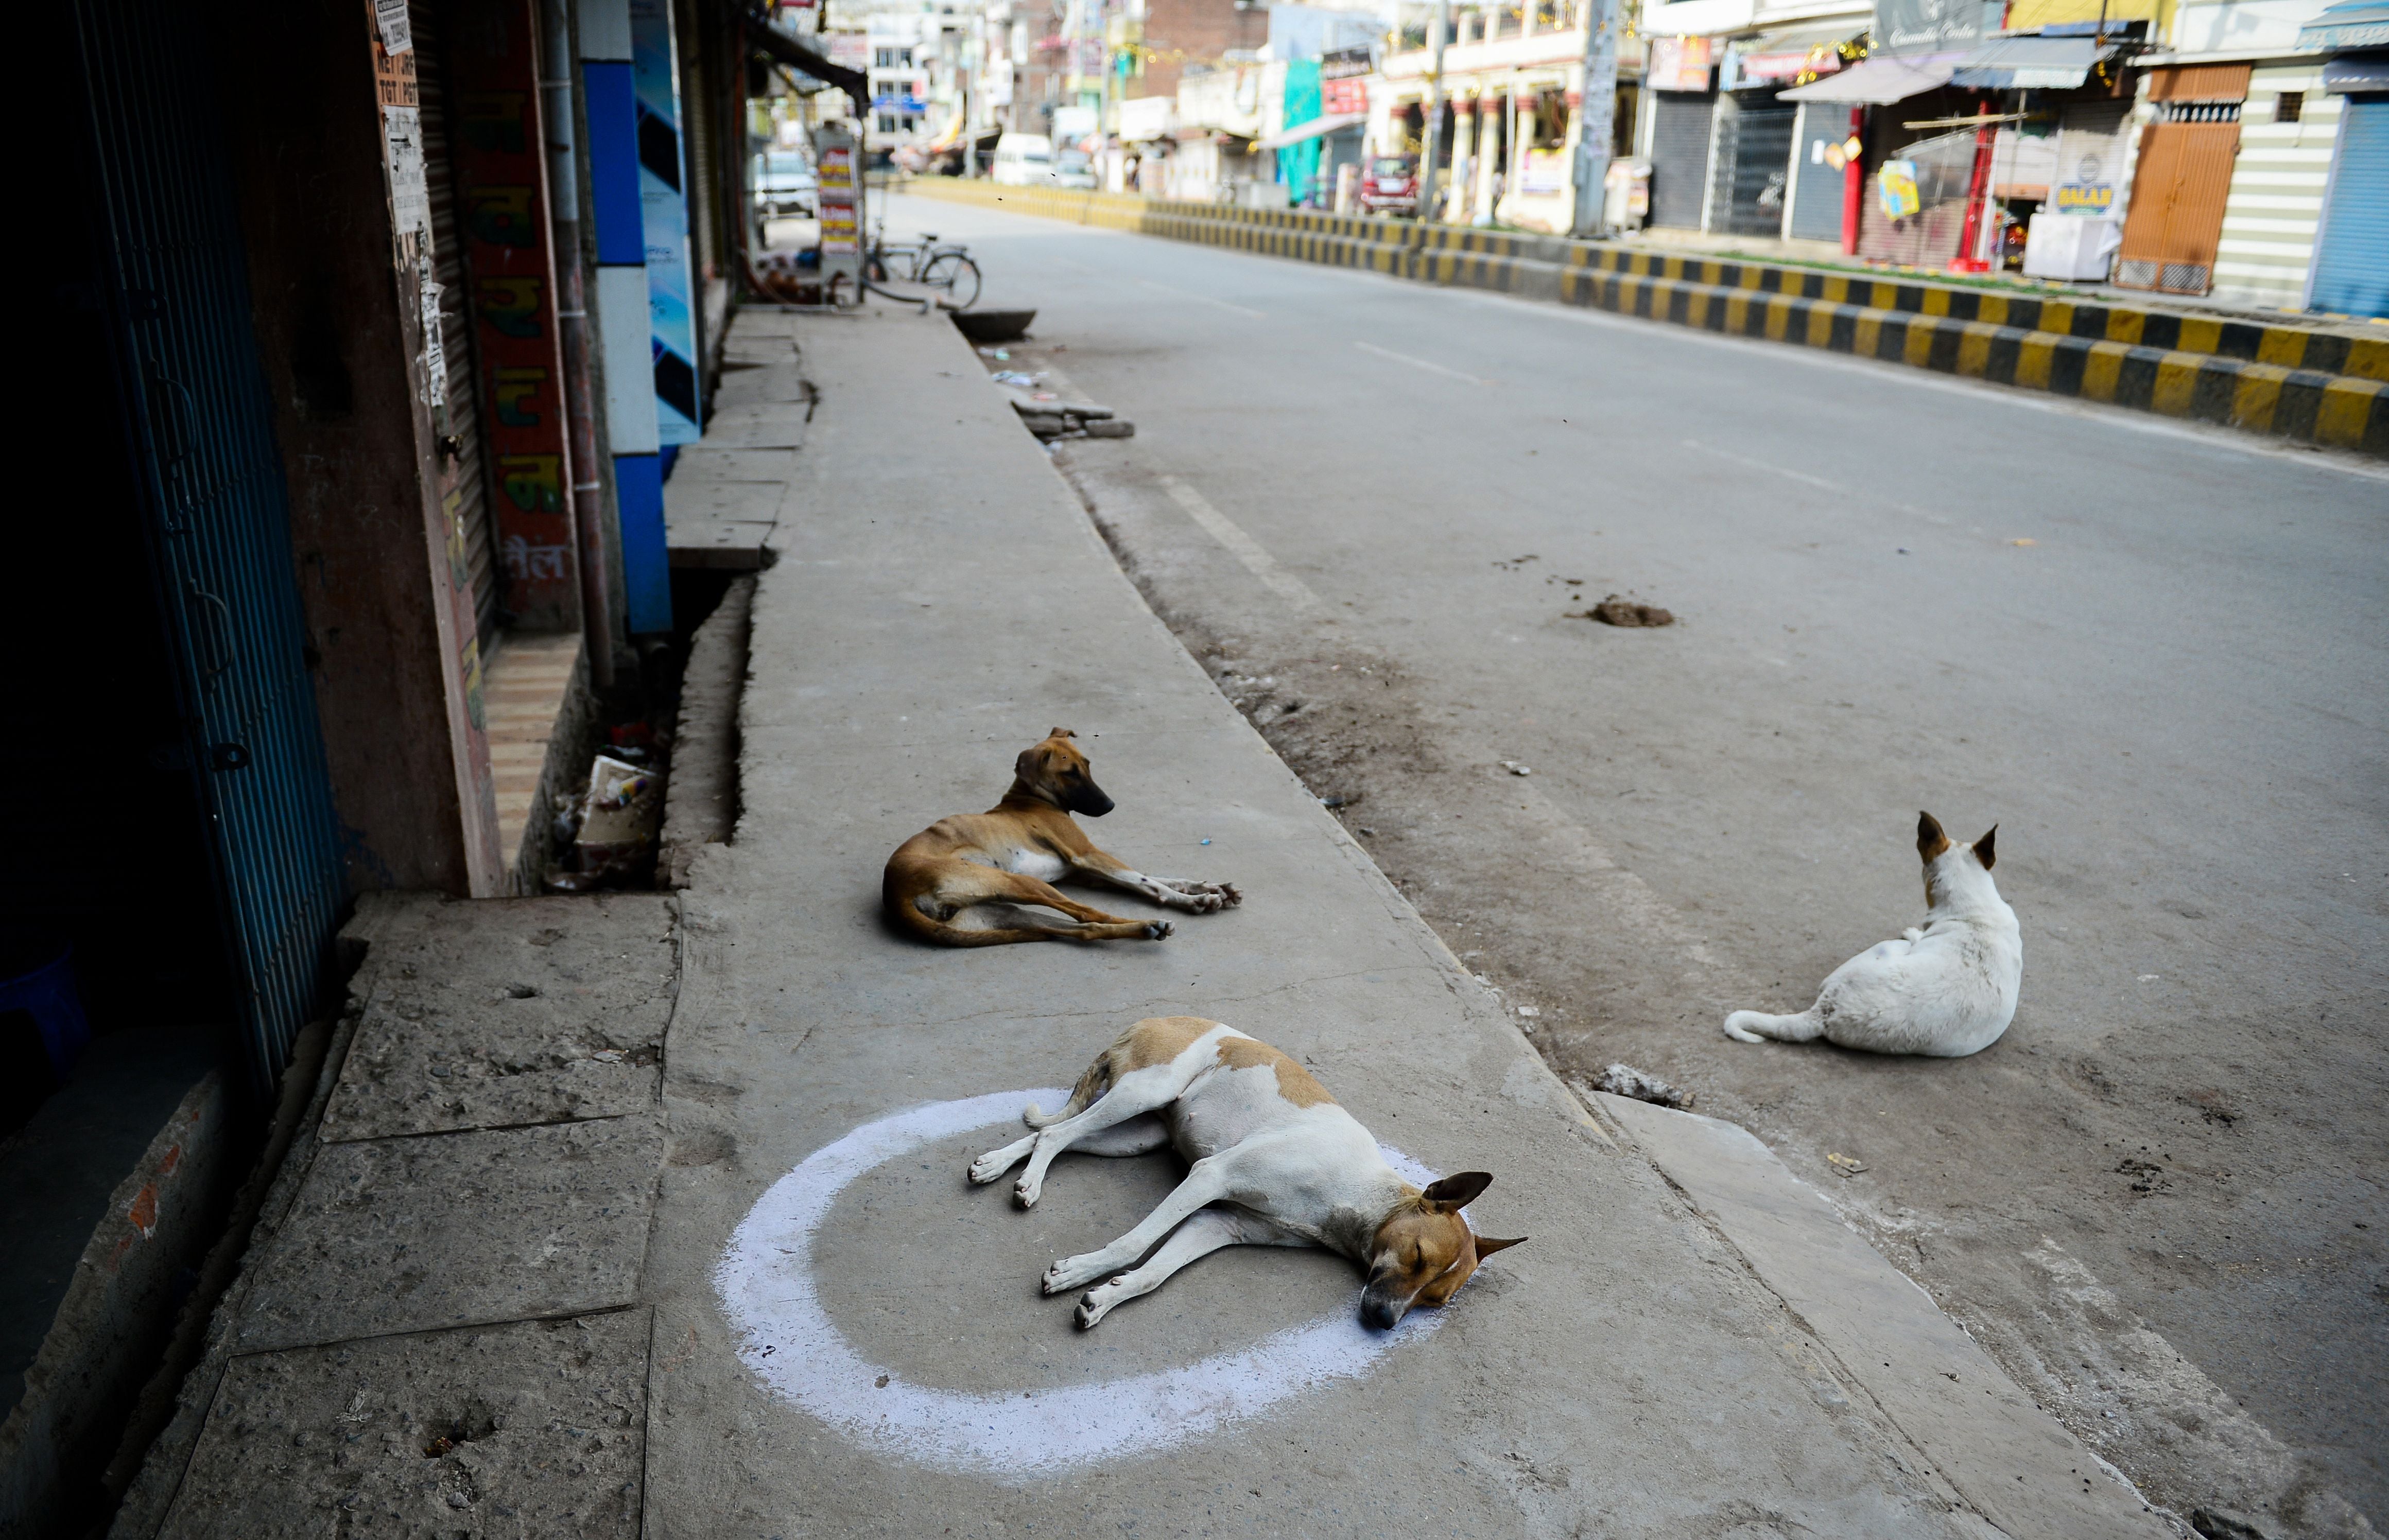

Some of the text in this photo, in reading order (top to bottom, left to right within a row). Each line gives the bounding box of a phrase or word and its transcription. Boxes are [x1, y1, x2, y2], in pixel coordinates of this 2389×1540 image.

[377, 50, 394, 74] NET
[379, 79, 417, 103] TGT PGT
